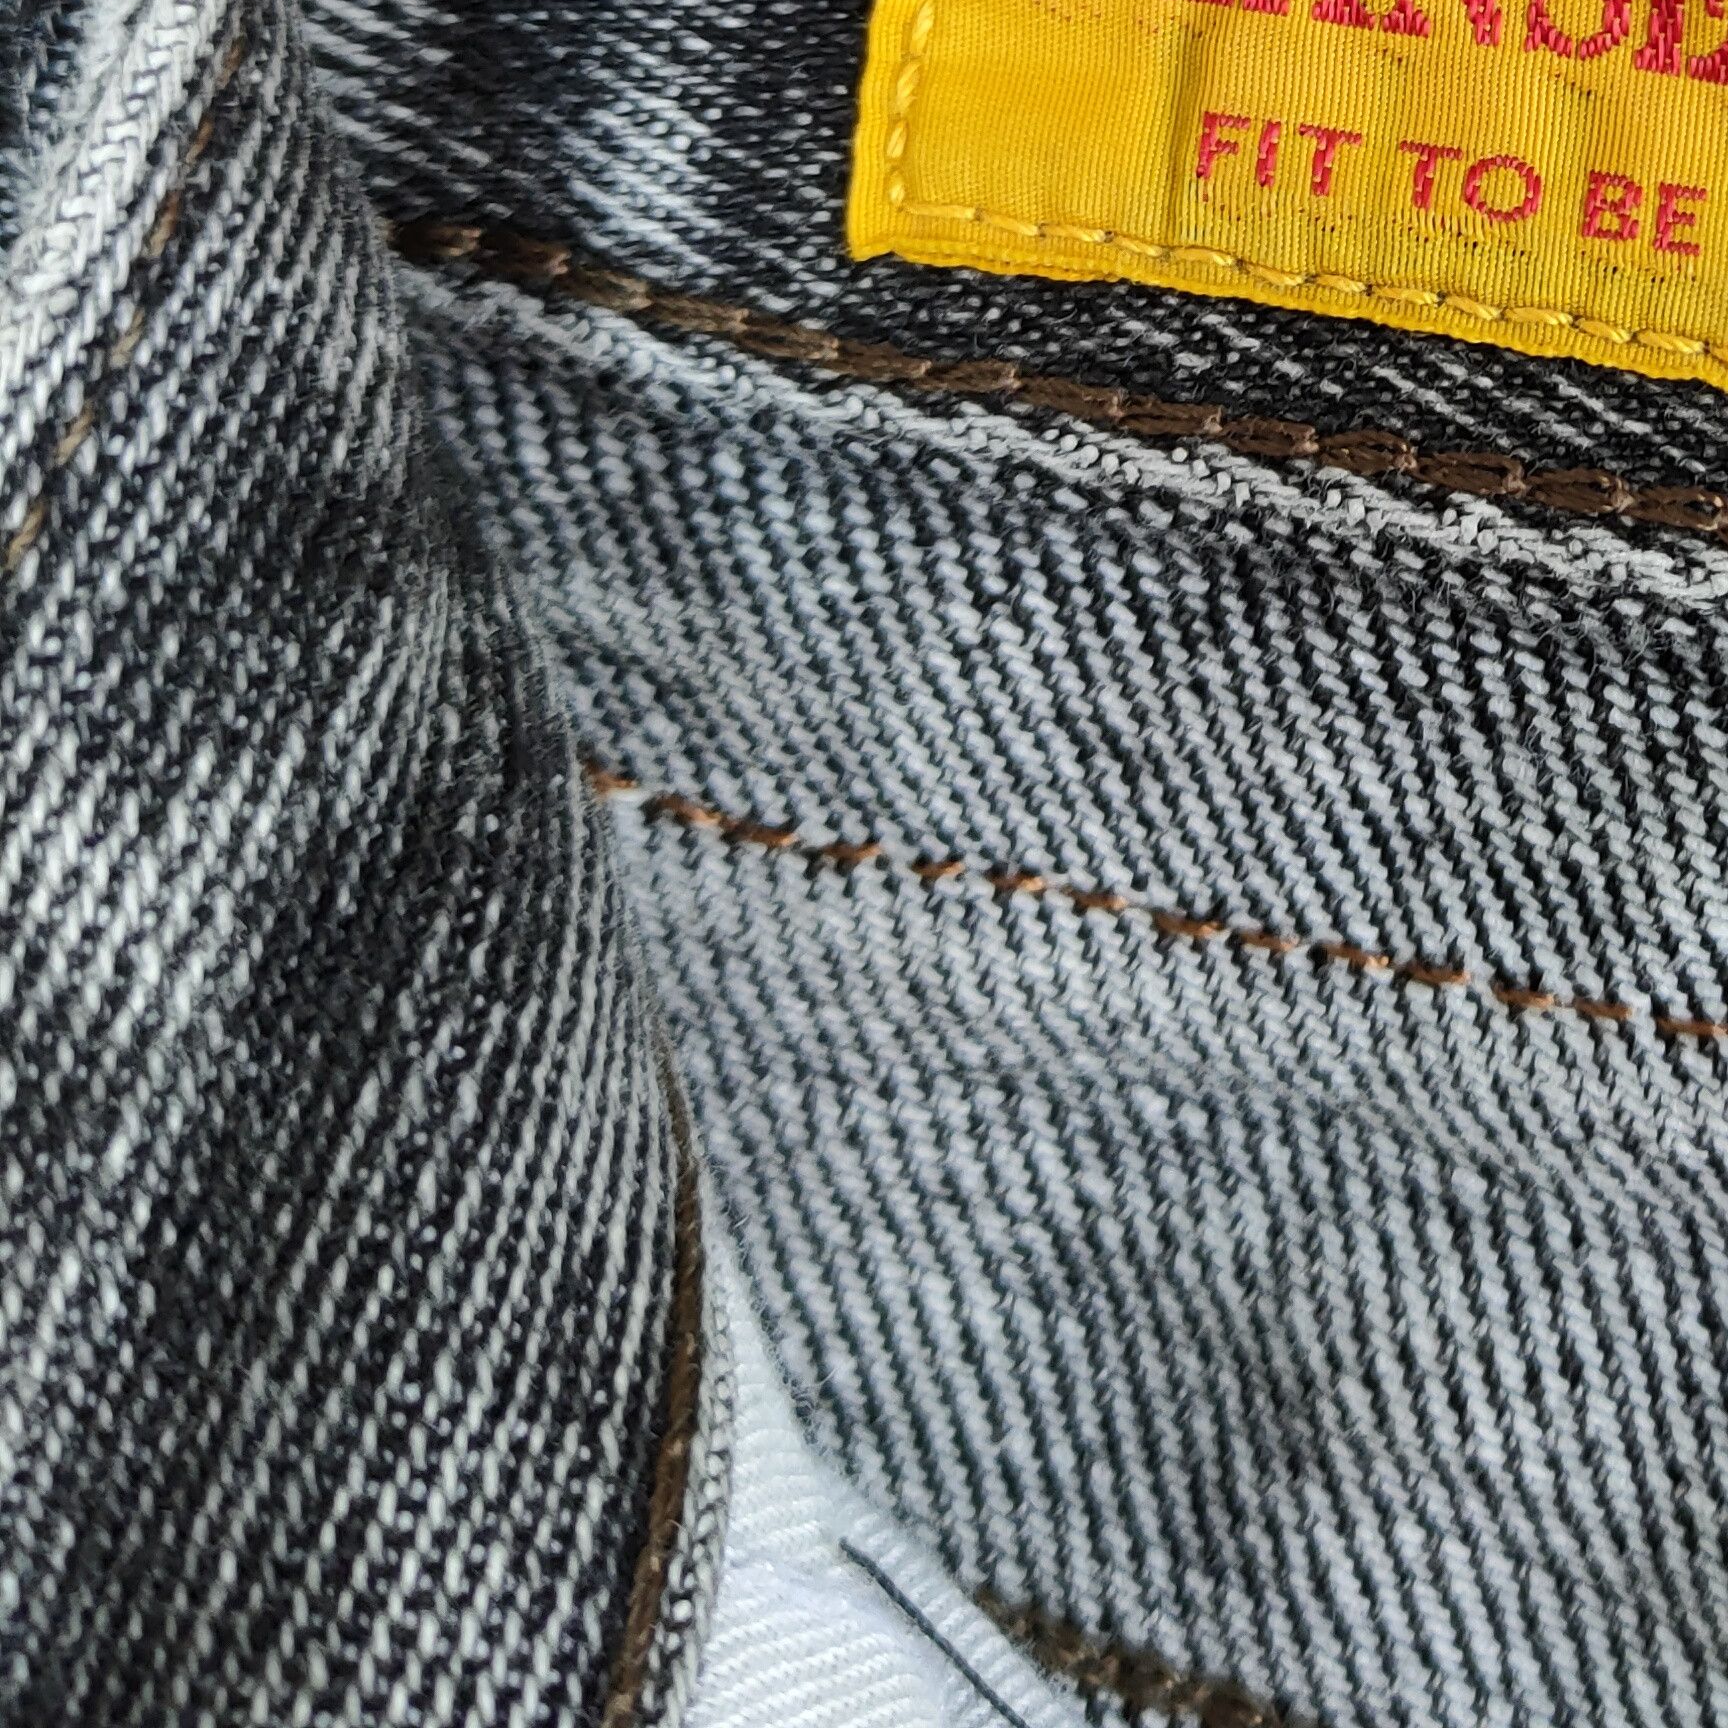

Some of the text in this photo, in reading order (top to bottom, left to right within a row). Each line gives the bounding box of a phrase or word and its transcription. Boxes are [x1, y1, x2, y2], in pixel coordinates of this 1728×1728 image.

[1197, 111, 1363, 196] FIT
[1402, 144, 1544, 225] TO
[1581, 169, 1708, 257] BE
